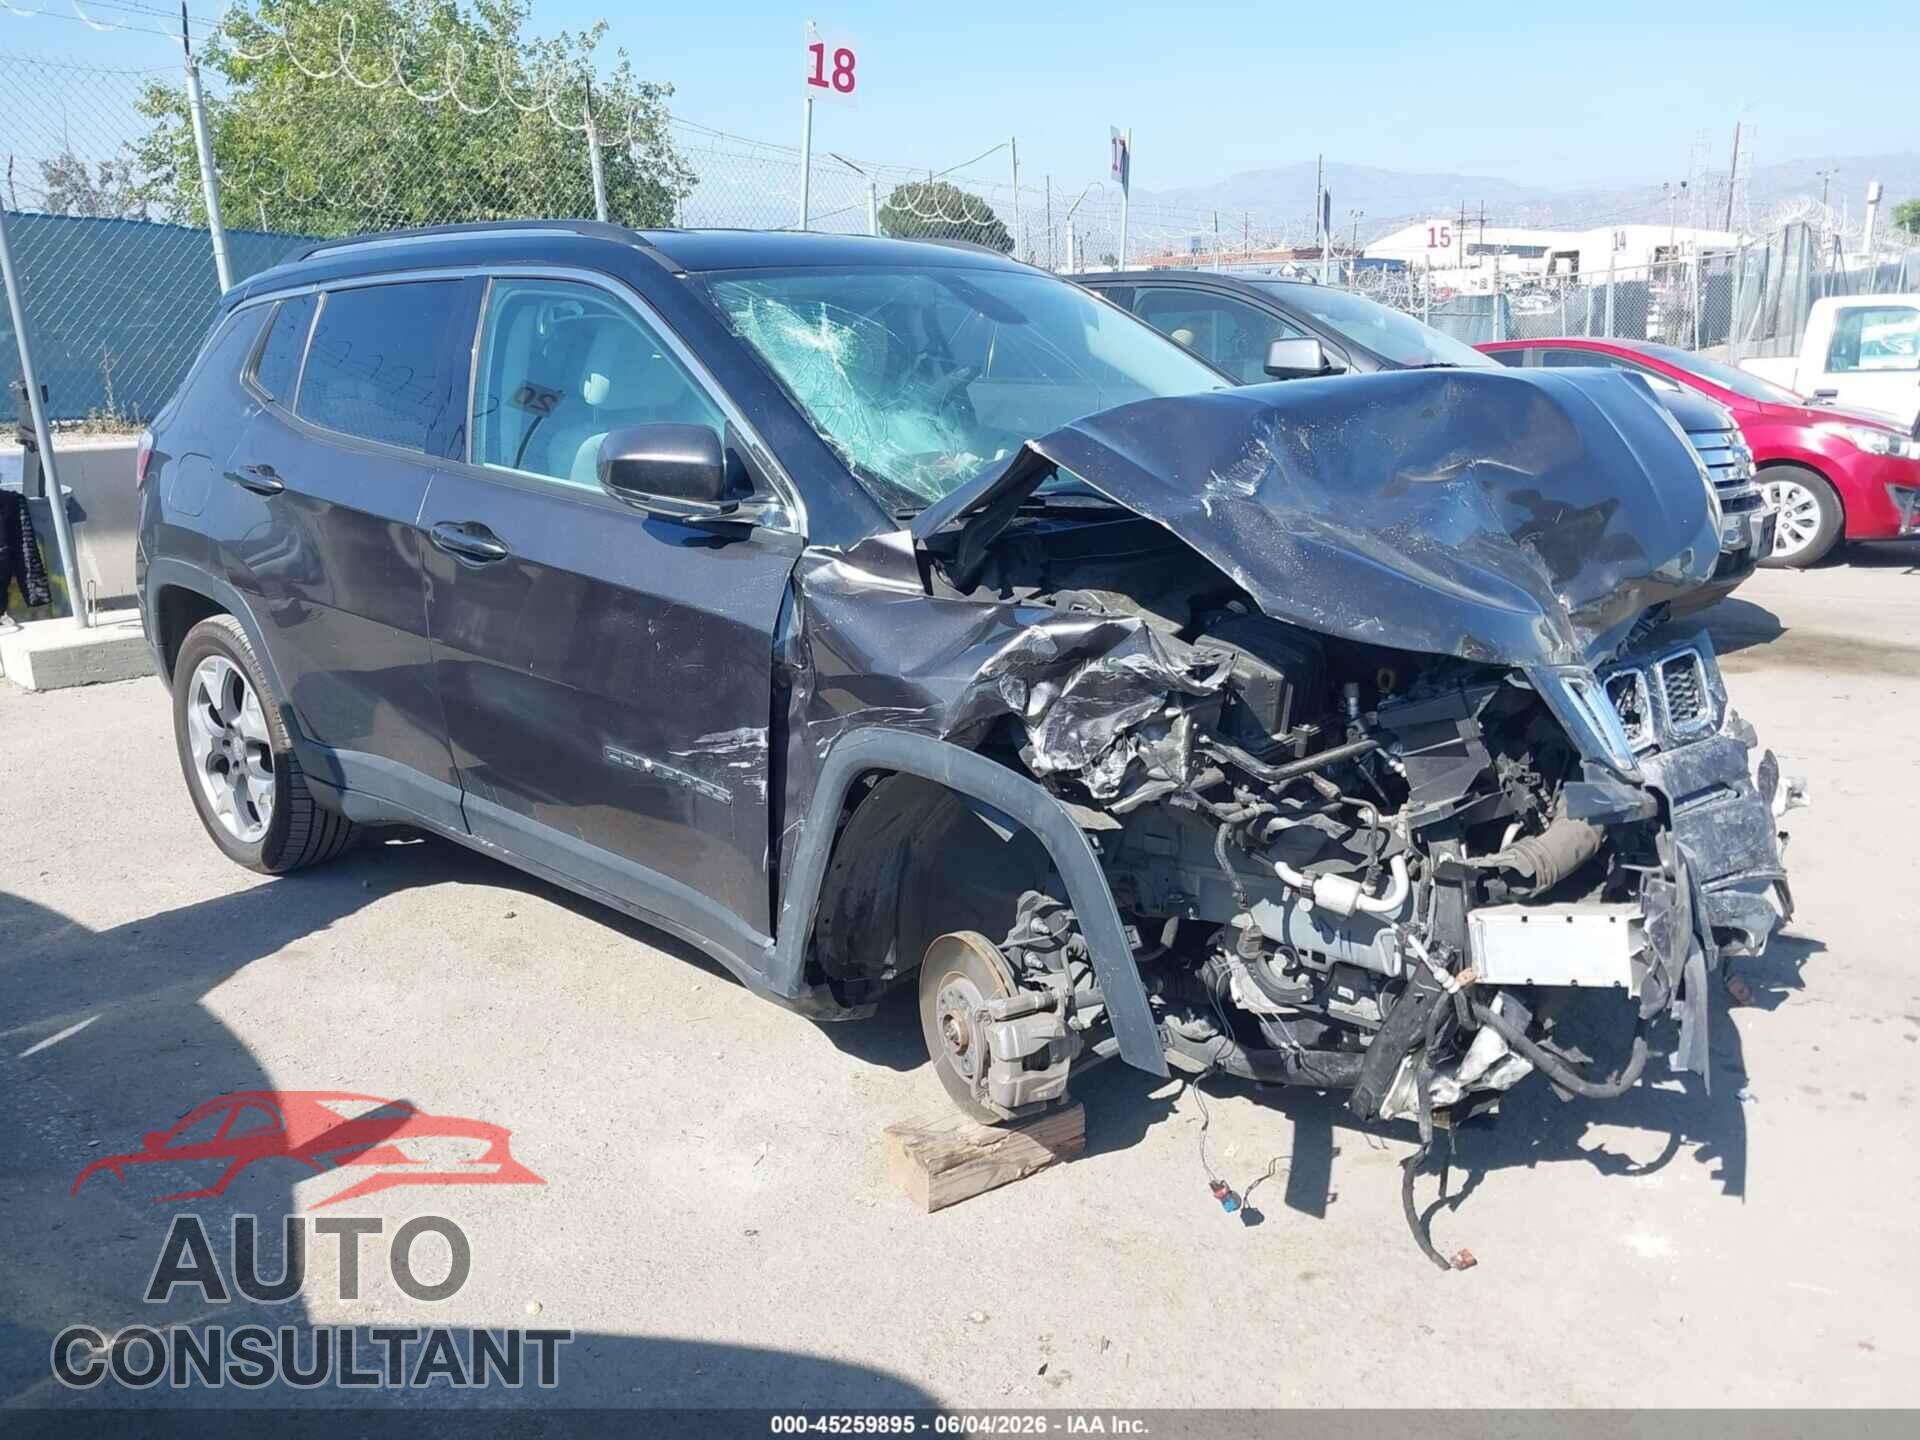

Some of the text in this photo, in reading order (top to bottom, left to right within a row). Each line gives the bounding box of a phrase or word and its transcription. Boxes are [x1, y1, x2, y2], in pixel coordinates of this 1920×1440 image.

[808, 43, 856, 93] 18
[1427, 226, 1451, 249] 15
[1613, 230, 1627, 252] 14
